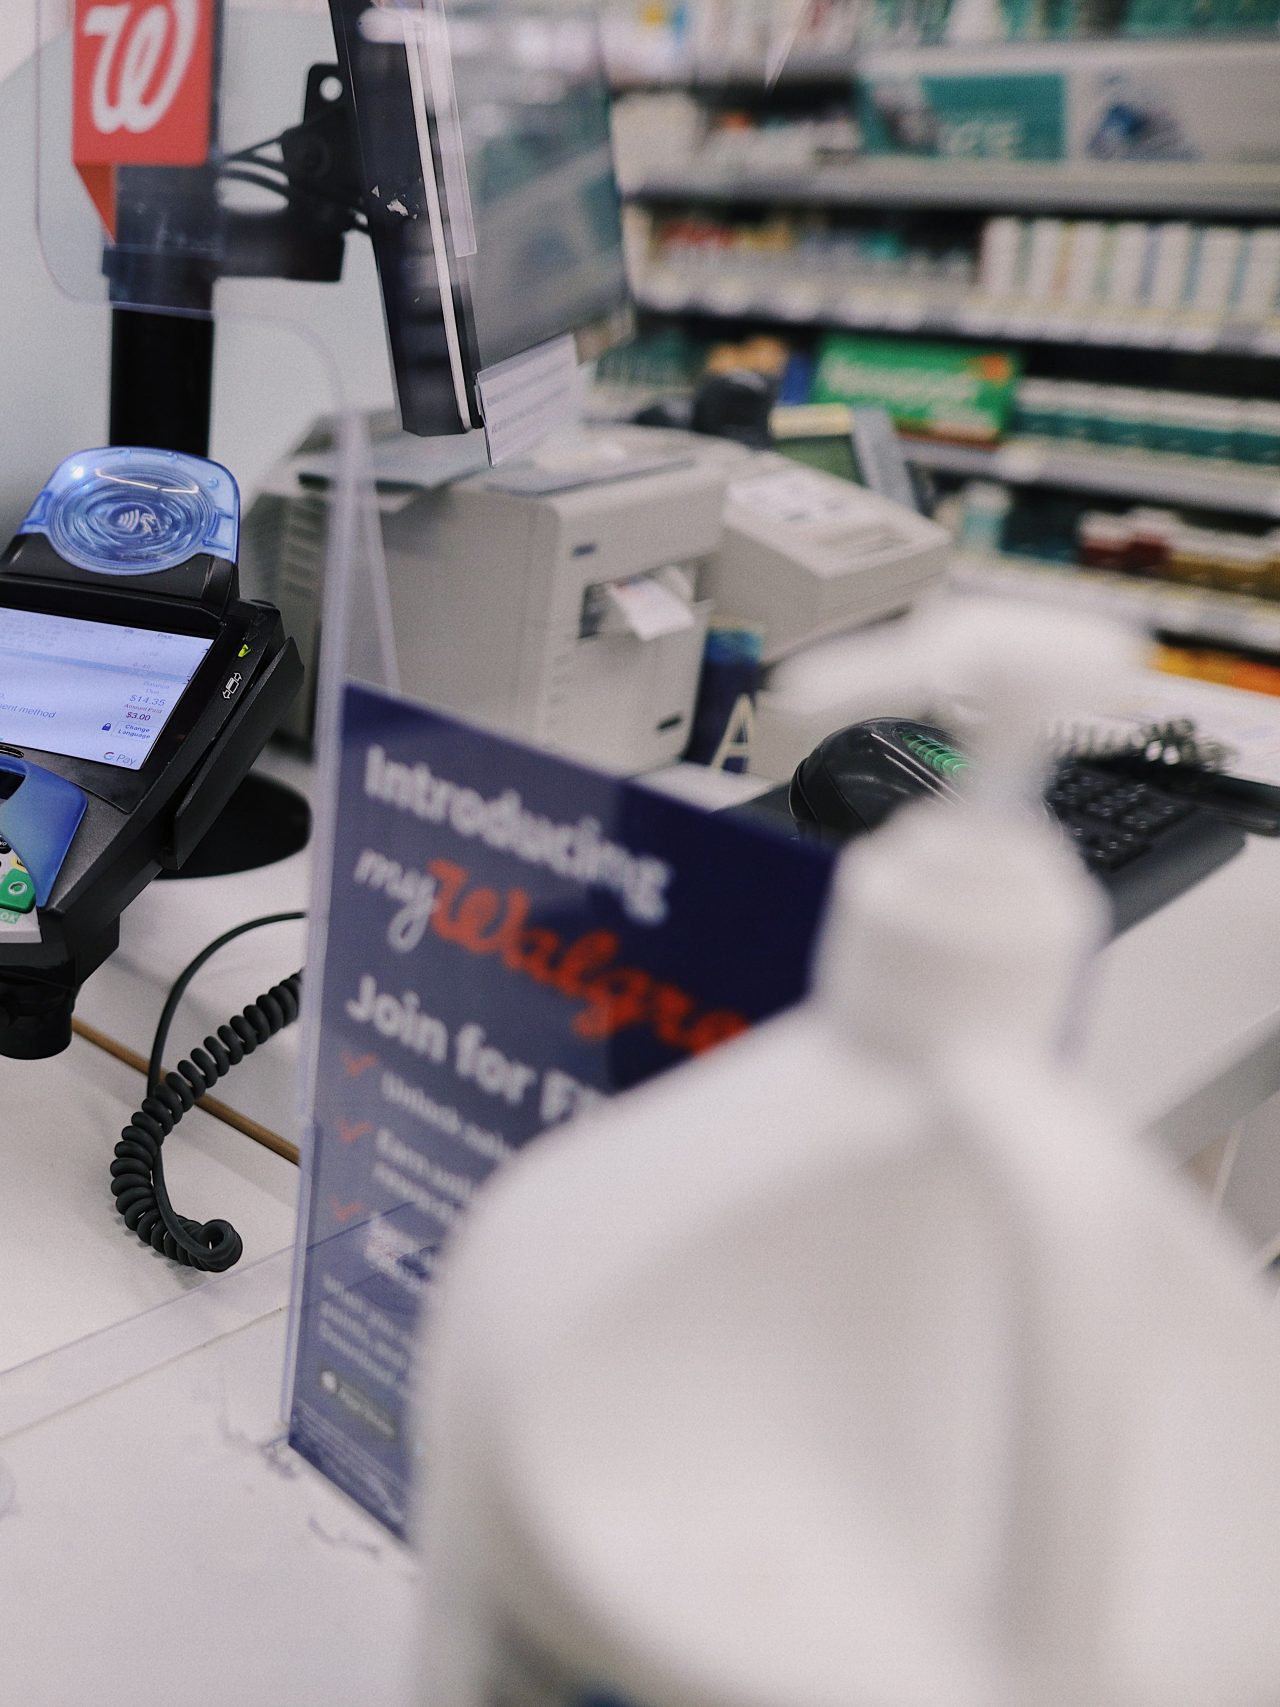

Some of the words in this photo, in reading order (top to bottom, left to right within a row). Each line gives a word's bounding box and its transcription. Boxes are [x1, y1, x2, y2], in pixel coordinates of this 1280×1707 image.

[129, 694, 167, 707] $14.35
[18, 704, 57, 719] method
[125, 711, 152, 722] $3.00
[117, 728, 152, 740] Language
[124, 724, 151, 733] Change
[116, 753, 138, 767] Pay
[363, 744, 675, 926] Introducing
[0, 912, 18, 924] OK
[346, 974, 447, 1063] Join
[455, 1024, 539, 1108] for
